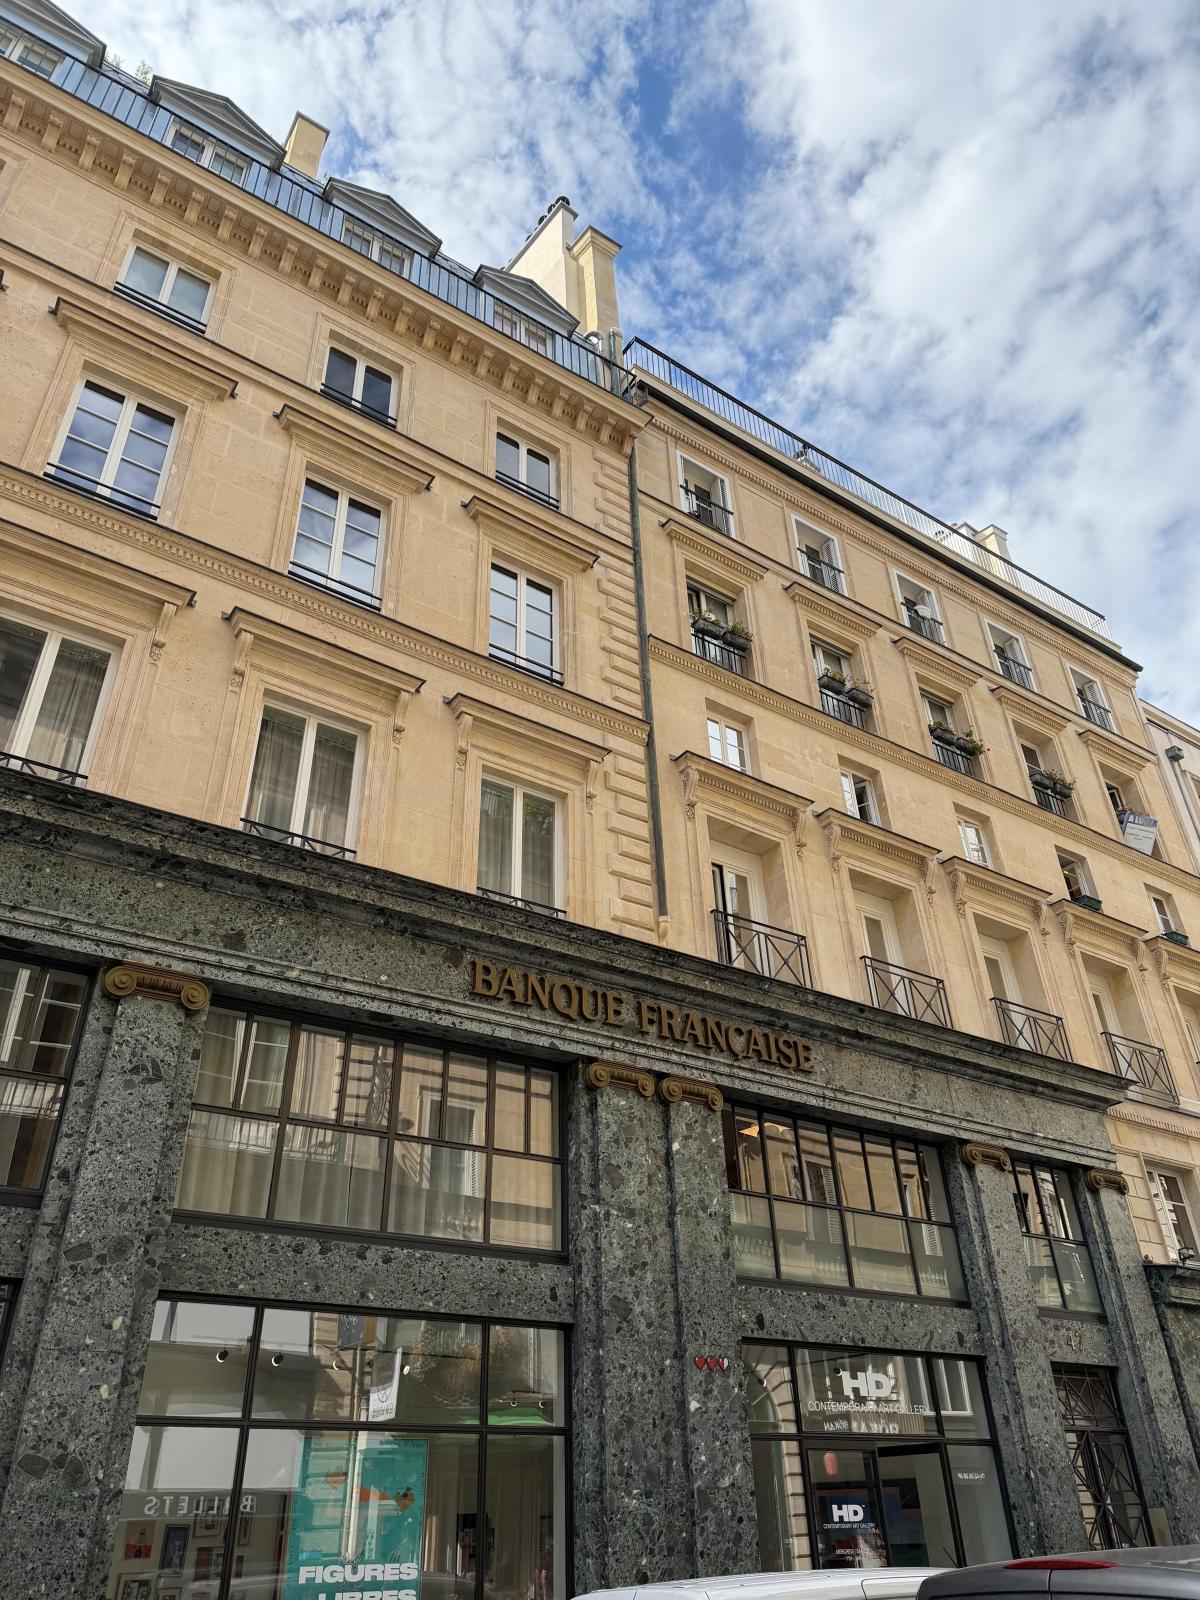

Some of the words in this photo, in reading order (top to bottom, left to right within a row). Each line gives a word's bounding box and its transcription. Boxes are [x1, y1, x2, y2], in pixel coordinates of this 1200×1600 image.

[471, 960, 624, 1027] BANQUE
[638, 1000, 814, 1073] FRANÇAISE
[842, 1371, 891, 1397] HD
[807, 1400, 876, 1413] CONTEMPORARY
[878, 1403, 896, 1413] ART
[896, 1404, 929, 1415] GALLERY
[832, 1505, 863, 1521] HD
[298, 1562, 418, 1585] FIGURES
